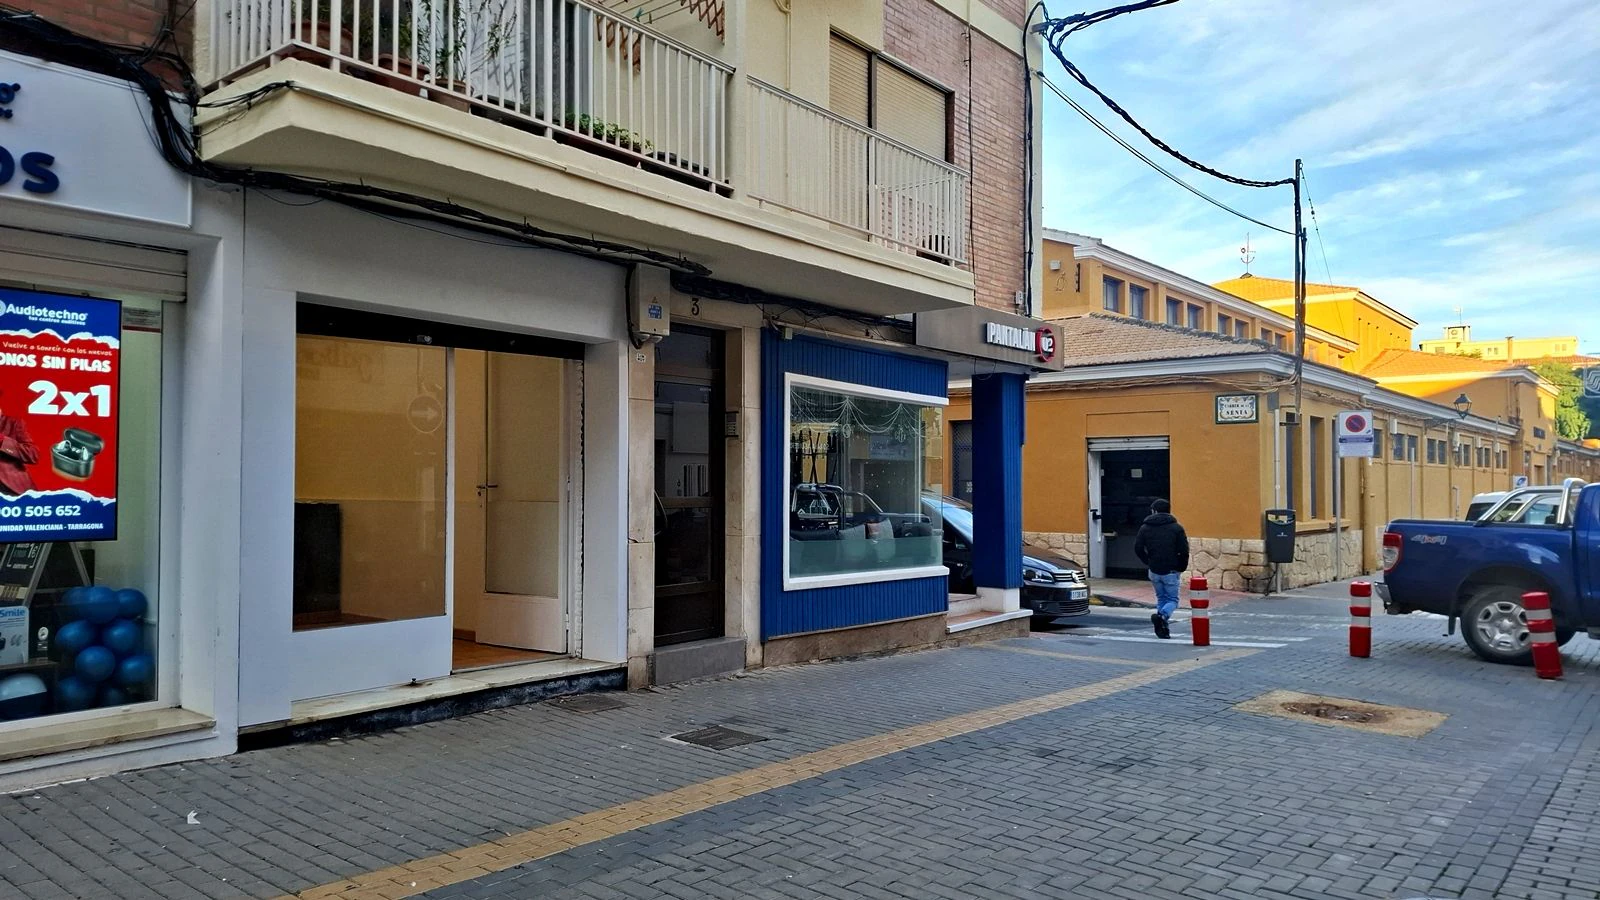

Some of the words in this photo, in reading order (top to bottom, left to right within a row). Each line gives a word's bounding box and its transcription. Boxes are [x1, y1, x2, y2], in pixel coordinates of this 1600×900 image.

[6, 304, 87, 321] Audiotechno
[692, 298, 699, 315] 3
[2, 341, 28, 349] Vuelve
[41, 355, 67, 370] SIN
[70, 358, 112, 373] PILAS
[27, 379, 111, 418] 2x1
[24, 505, 52, 517] 505
[55, 505, 81, 517] 652
